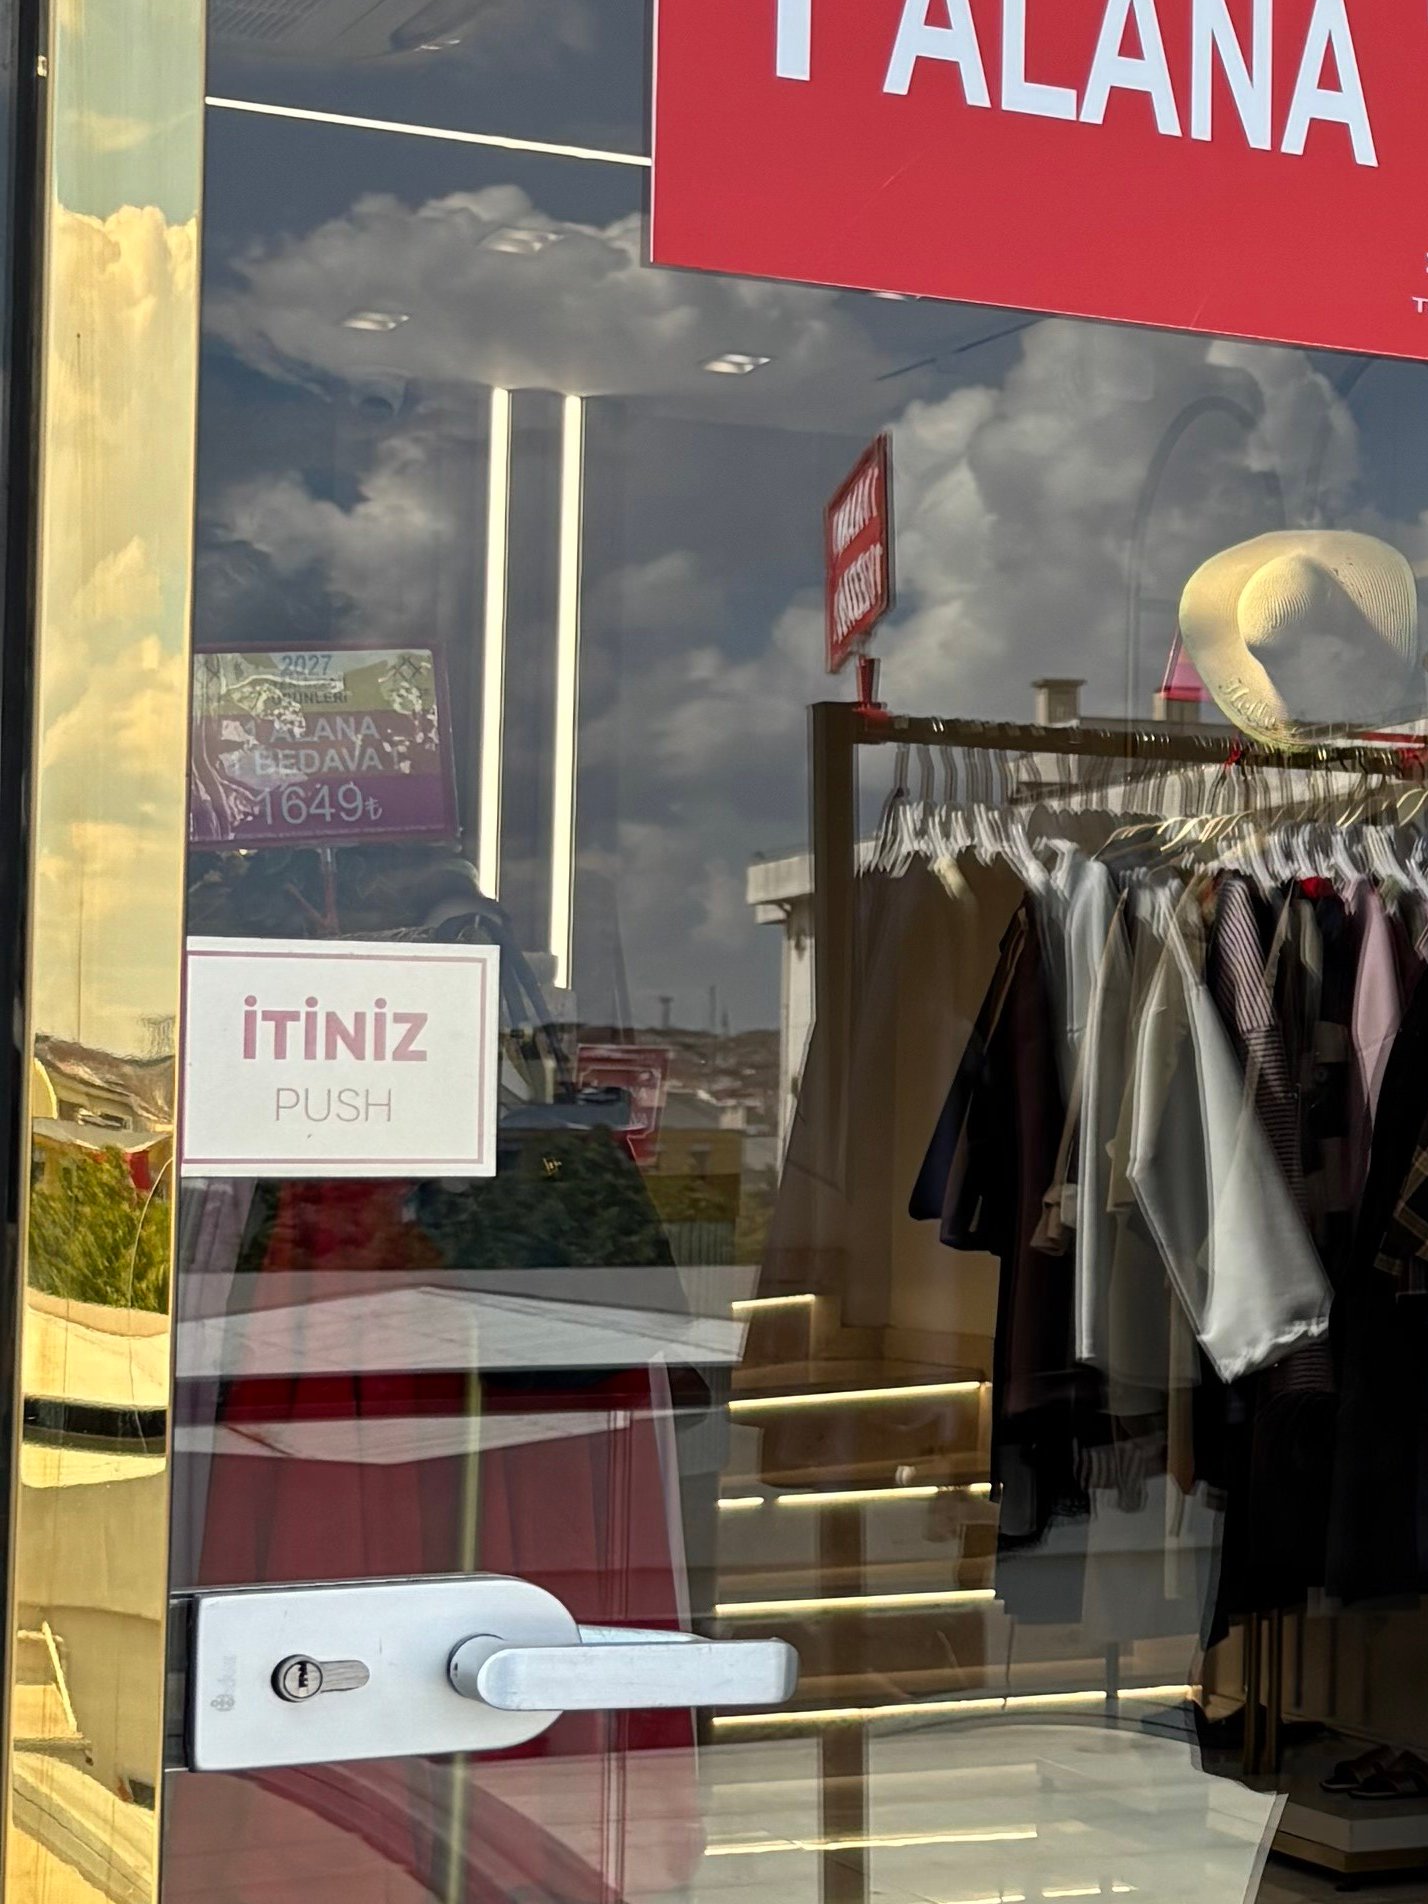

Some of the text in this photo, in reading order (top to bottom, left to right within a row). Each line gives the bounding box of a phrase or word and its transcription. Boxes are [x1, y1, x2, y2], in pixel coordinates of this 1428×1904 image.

[254, 746, 383, 776] BEDAVA
[243, 994, 429, 1062] İTİNİZ
[275, 1087, 393, 1123] PUSH
